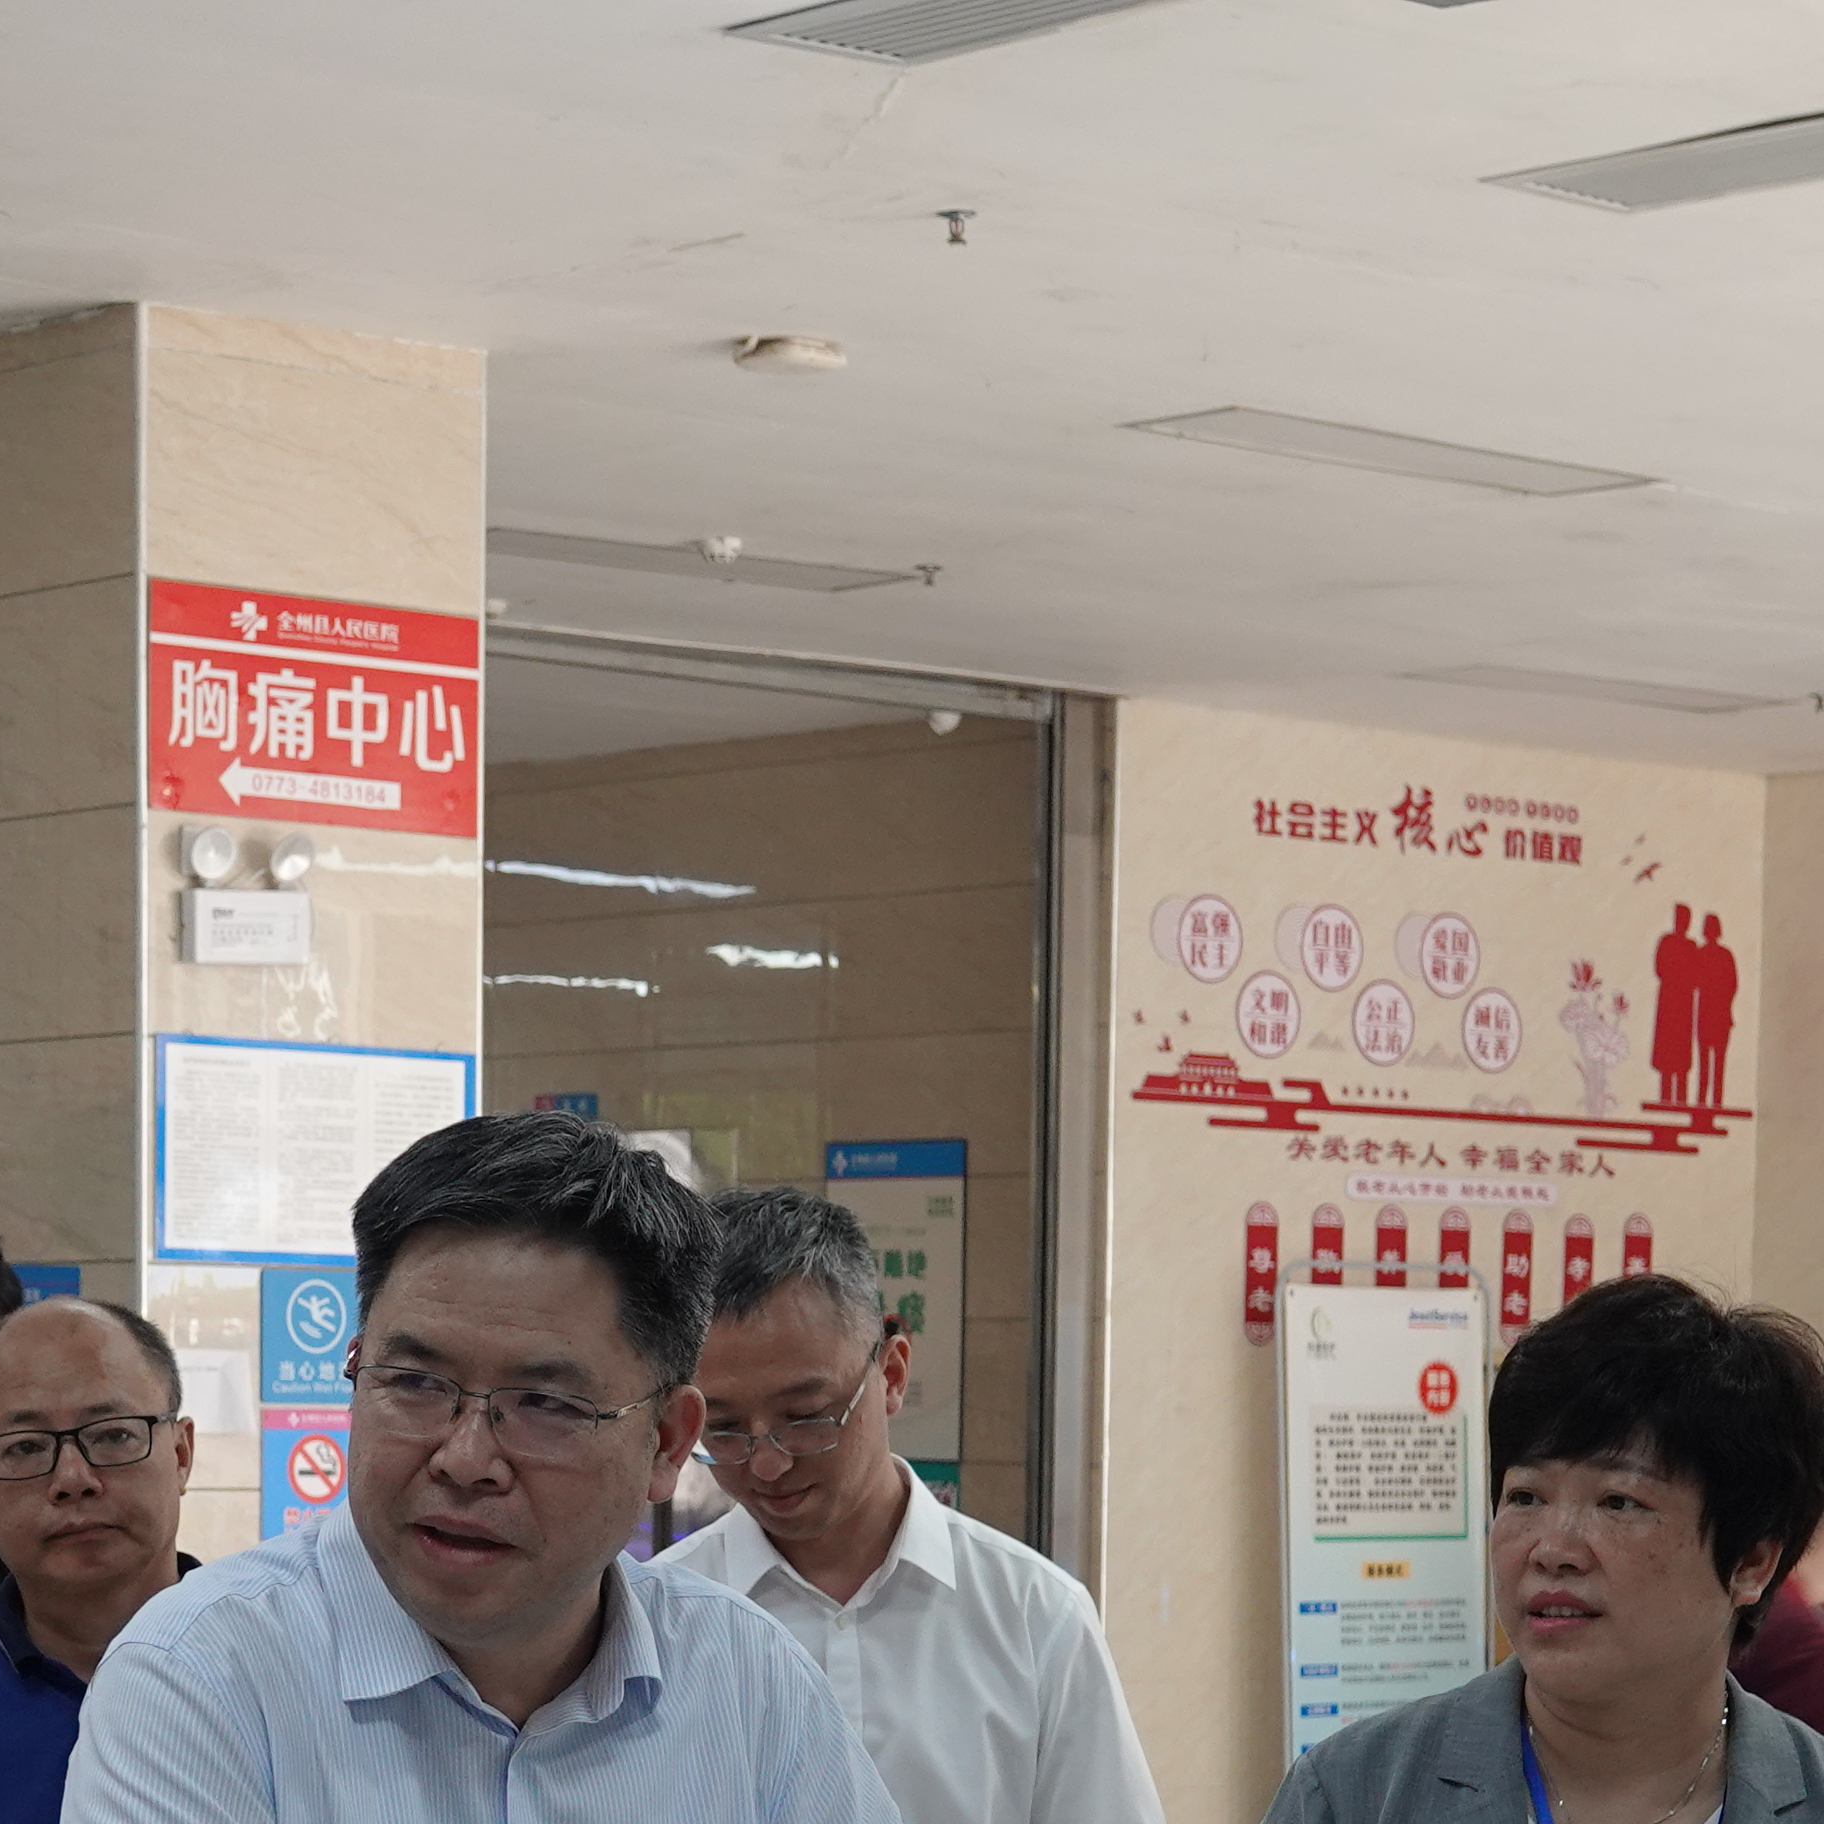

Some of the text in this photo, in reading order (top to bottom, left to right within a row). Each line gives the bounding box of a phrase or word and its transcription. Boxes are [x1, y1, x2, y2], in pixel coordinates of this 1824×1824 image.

[277, 611, 400, 645] 全州县人民医院
[168, 659, 465, 772] 胸痛中心
[252, 772, 386, 804] 0773-4813184
[1286, 1135, 1616, 1178] 关爱老年人 幸福全家人
